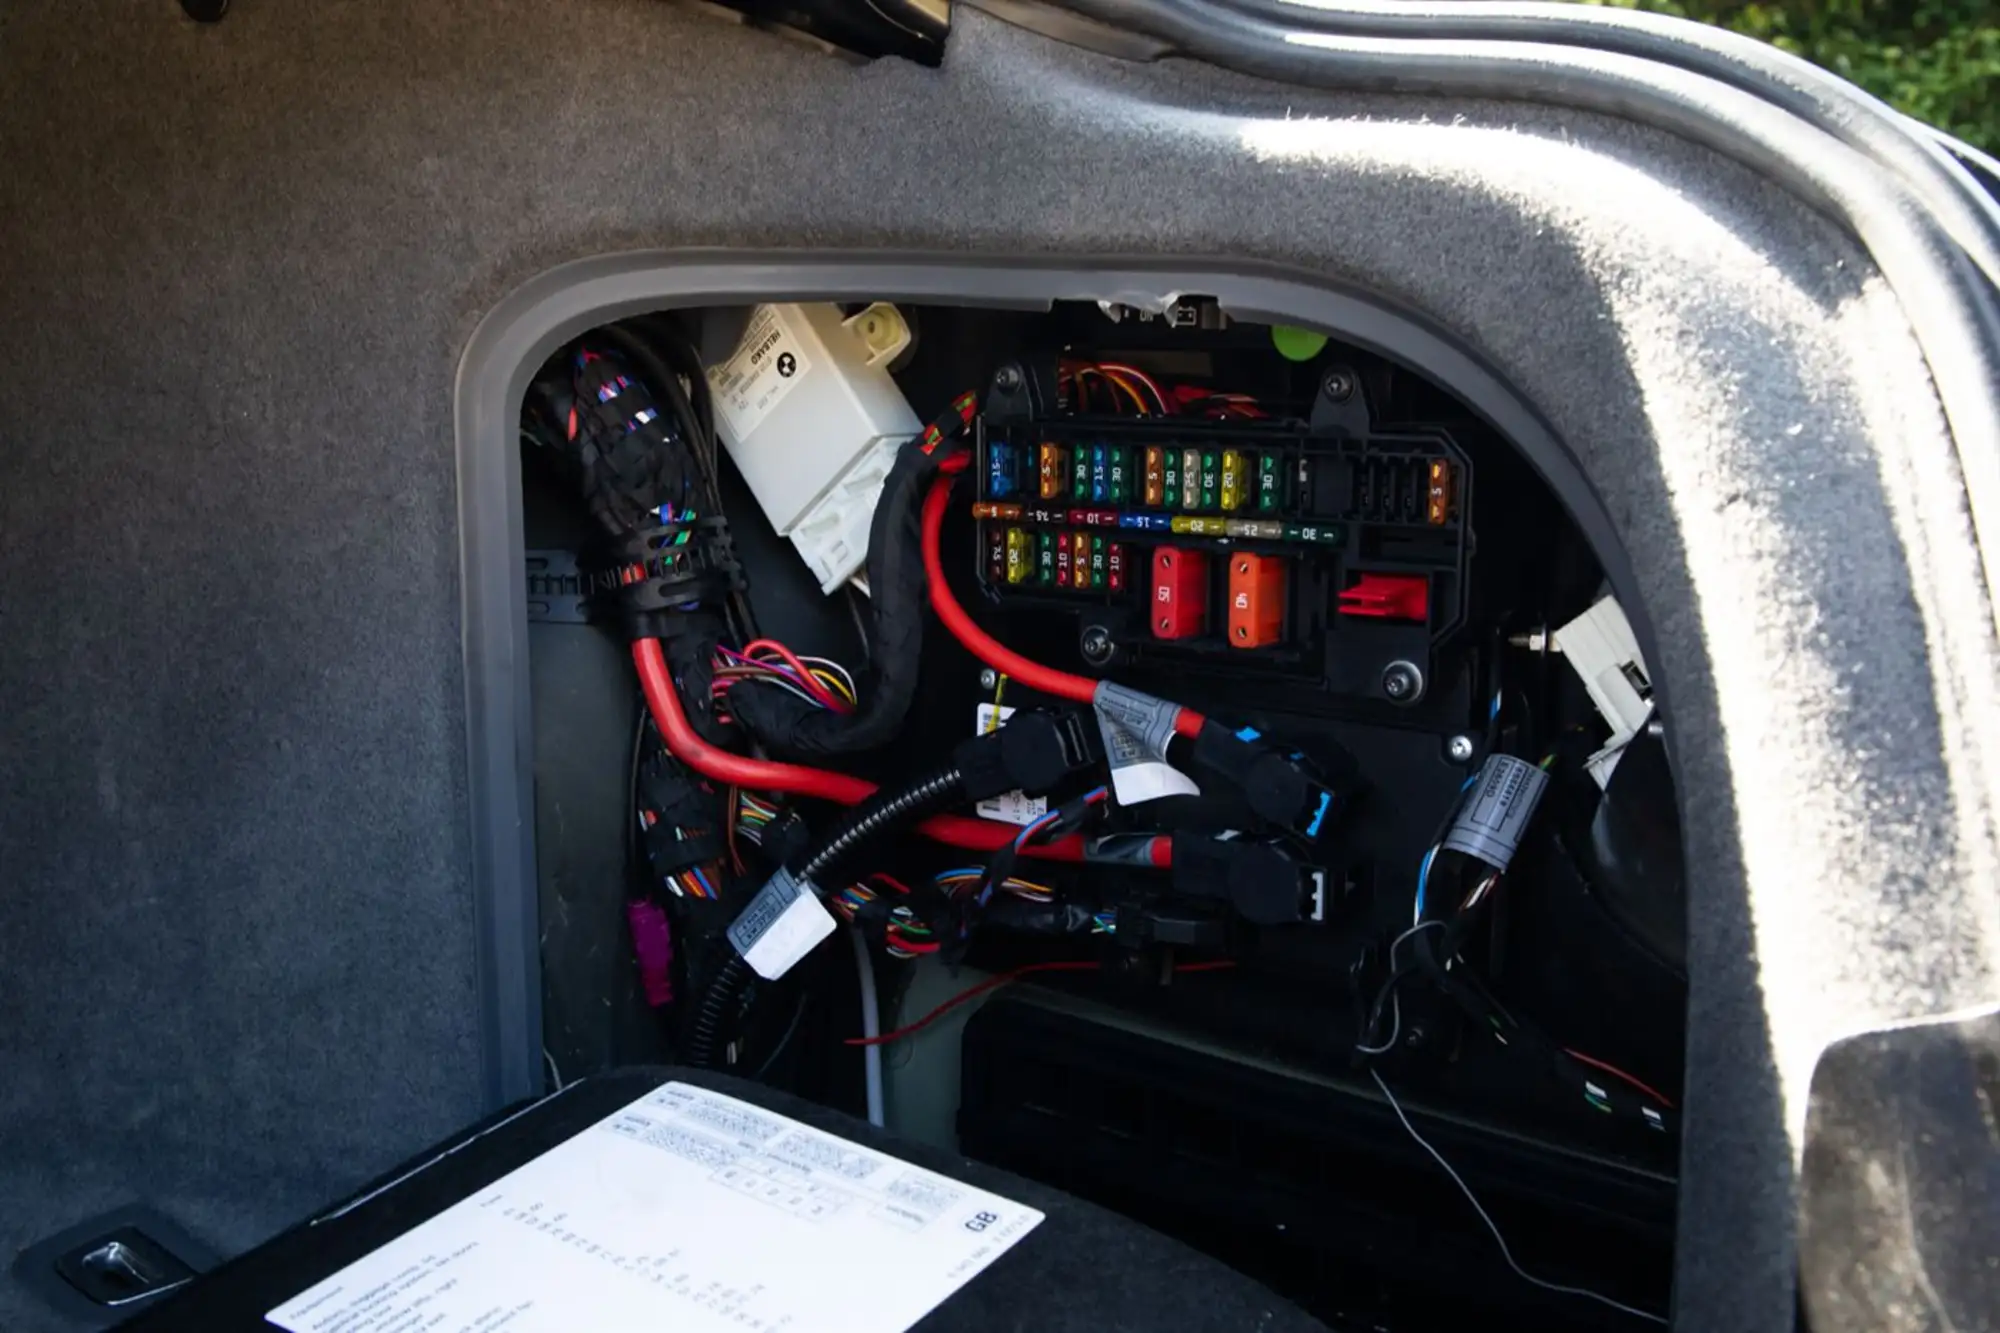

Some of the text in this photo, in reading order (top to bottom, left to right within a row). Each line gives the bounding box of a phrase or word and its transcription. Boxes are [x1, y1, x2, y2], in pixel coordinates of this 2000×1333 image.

[750, 330, 781, 365] HELBAKO
[992, 461, 1000, 476] 15
[1077, 465, 1085, 478] 30
[1095, 466, 1103, 480] 15
[1113, 467, 1121, 480] 30
[1167, 471, 1175, 485] 30
[1204, 473, 1213, 487] 30
[1224, 473, 1234, 487] 20
[1263, 475, 1273, 489] 30
[1087, 513, 1098, 524] 10
[1137, 517, 1149, 527] 15
[1191, 520, 1204, 531] 20
[1303, 528, 1316, 540] 30
[1009, 549, 1018, 563] 20
[1043, 552, 1051, 565] 30
[1059, 553, 1067, 567] 10
[1093, 555, 1102, 569] 30
[1111, 556, 1119, 570] 10
[1159, 587, 1169, 601] 50
[1236, 593, 1247, 608] 40
[964, 1211, 998, 1233] GB
